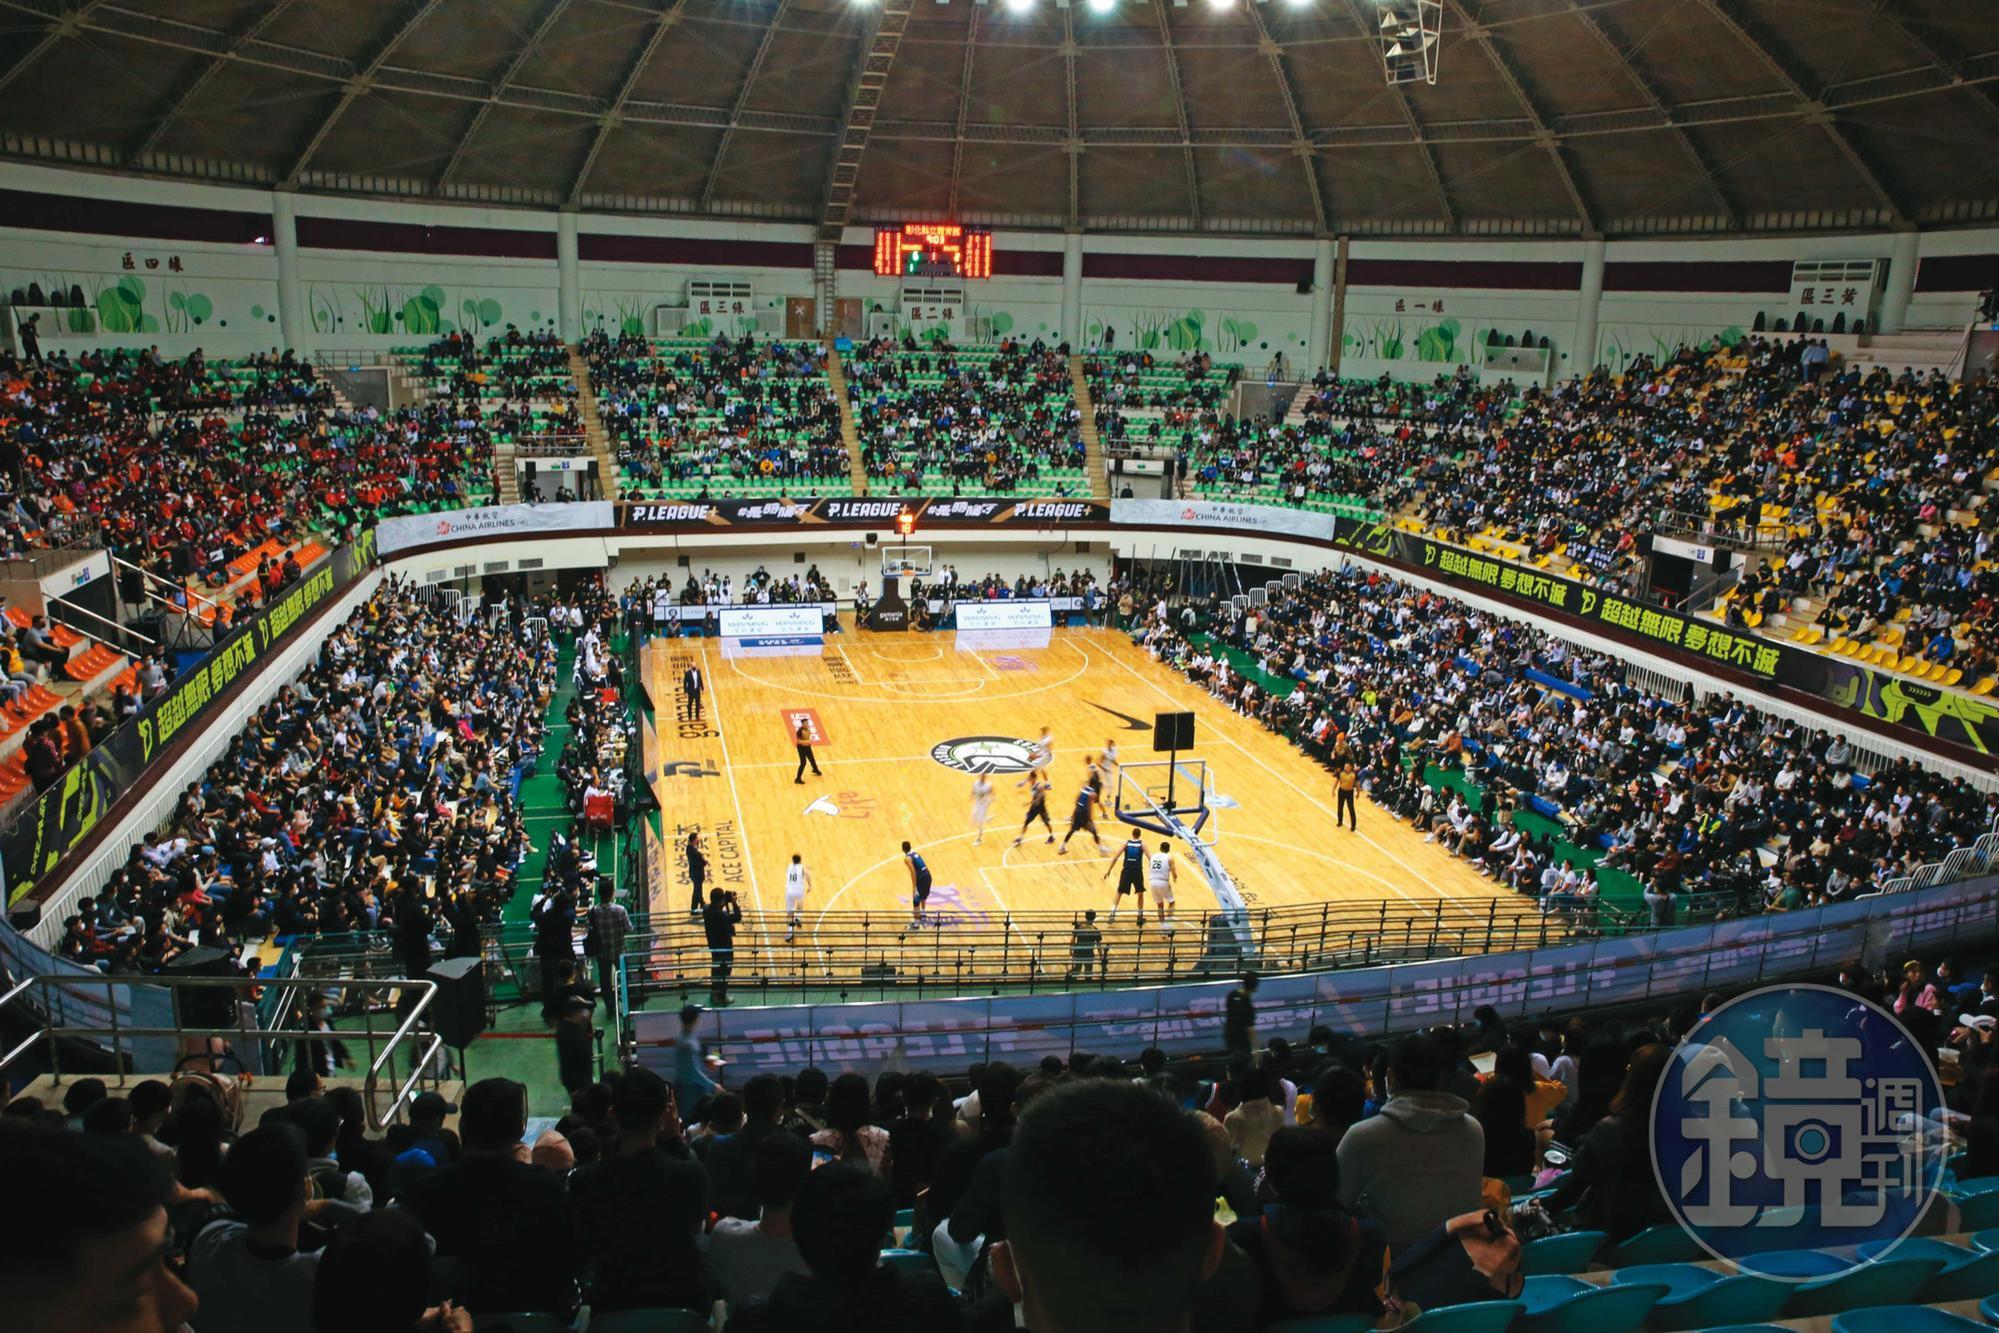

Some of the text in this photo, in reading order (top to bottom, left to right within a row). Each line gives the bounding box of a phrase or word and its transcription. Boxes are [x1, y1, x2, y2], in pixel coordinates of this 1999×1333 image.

[632, 504, 719, 521] P.LEAGUE+
[828, 502, 910, 518] P.LEAGUE+
[1014, 502, 1093, 518] P.LEAGUE+
[1195, 513, 1258, 525] CHINA AIRLINES
[451, 519, 515, 533] CHINA AIRLINES
[1439, 550, 1498, 582] 超越無限
[1600, 598, 1683, 644] 超越無限
[156, 667, 211, 745] 超越無限
[715, 820, 740, 860] CAPITAL
[721, 862, 745, 883] ACE
